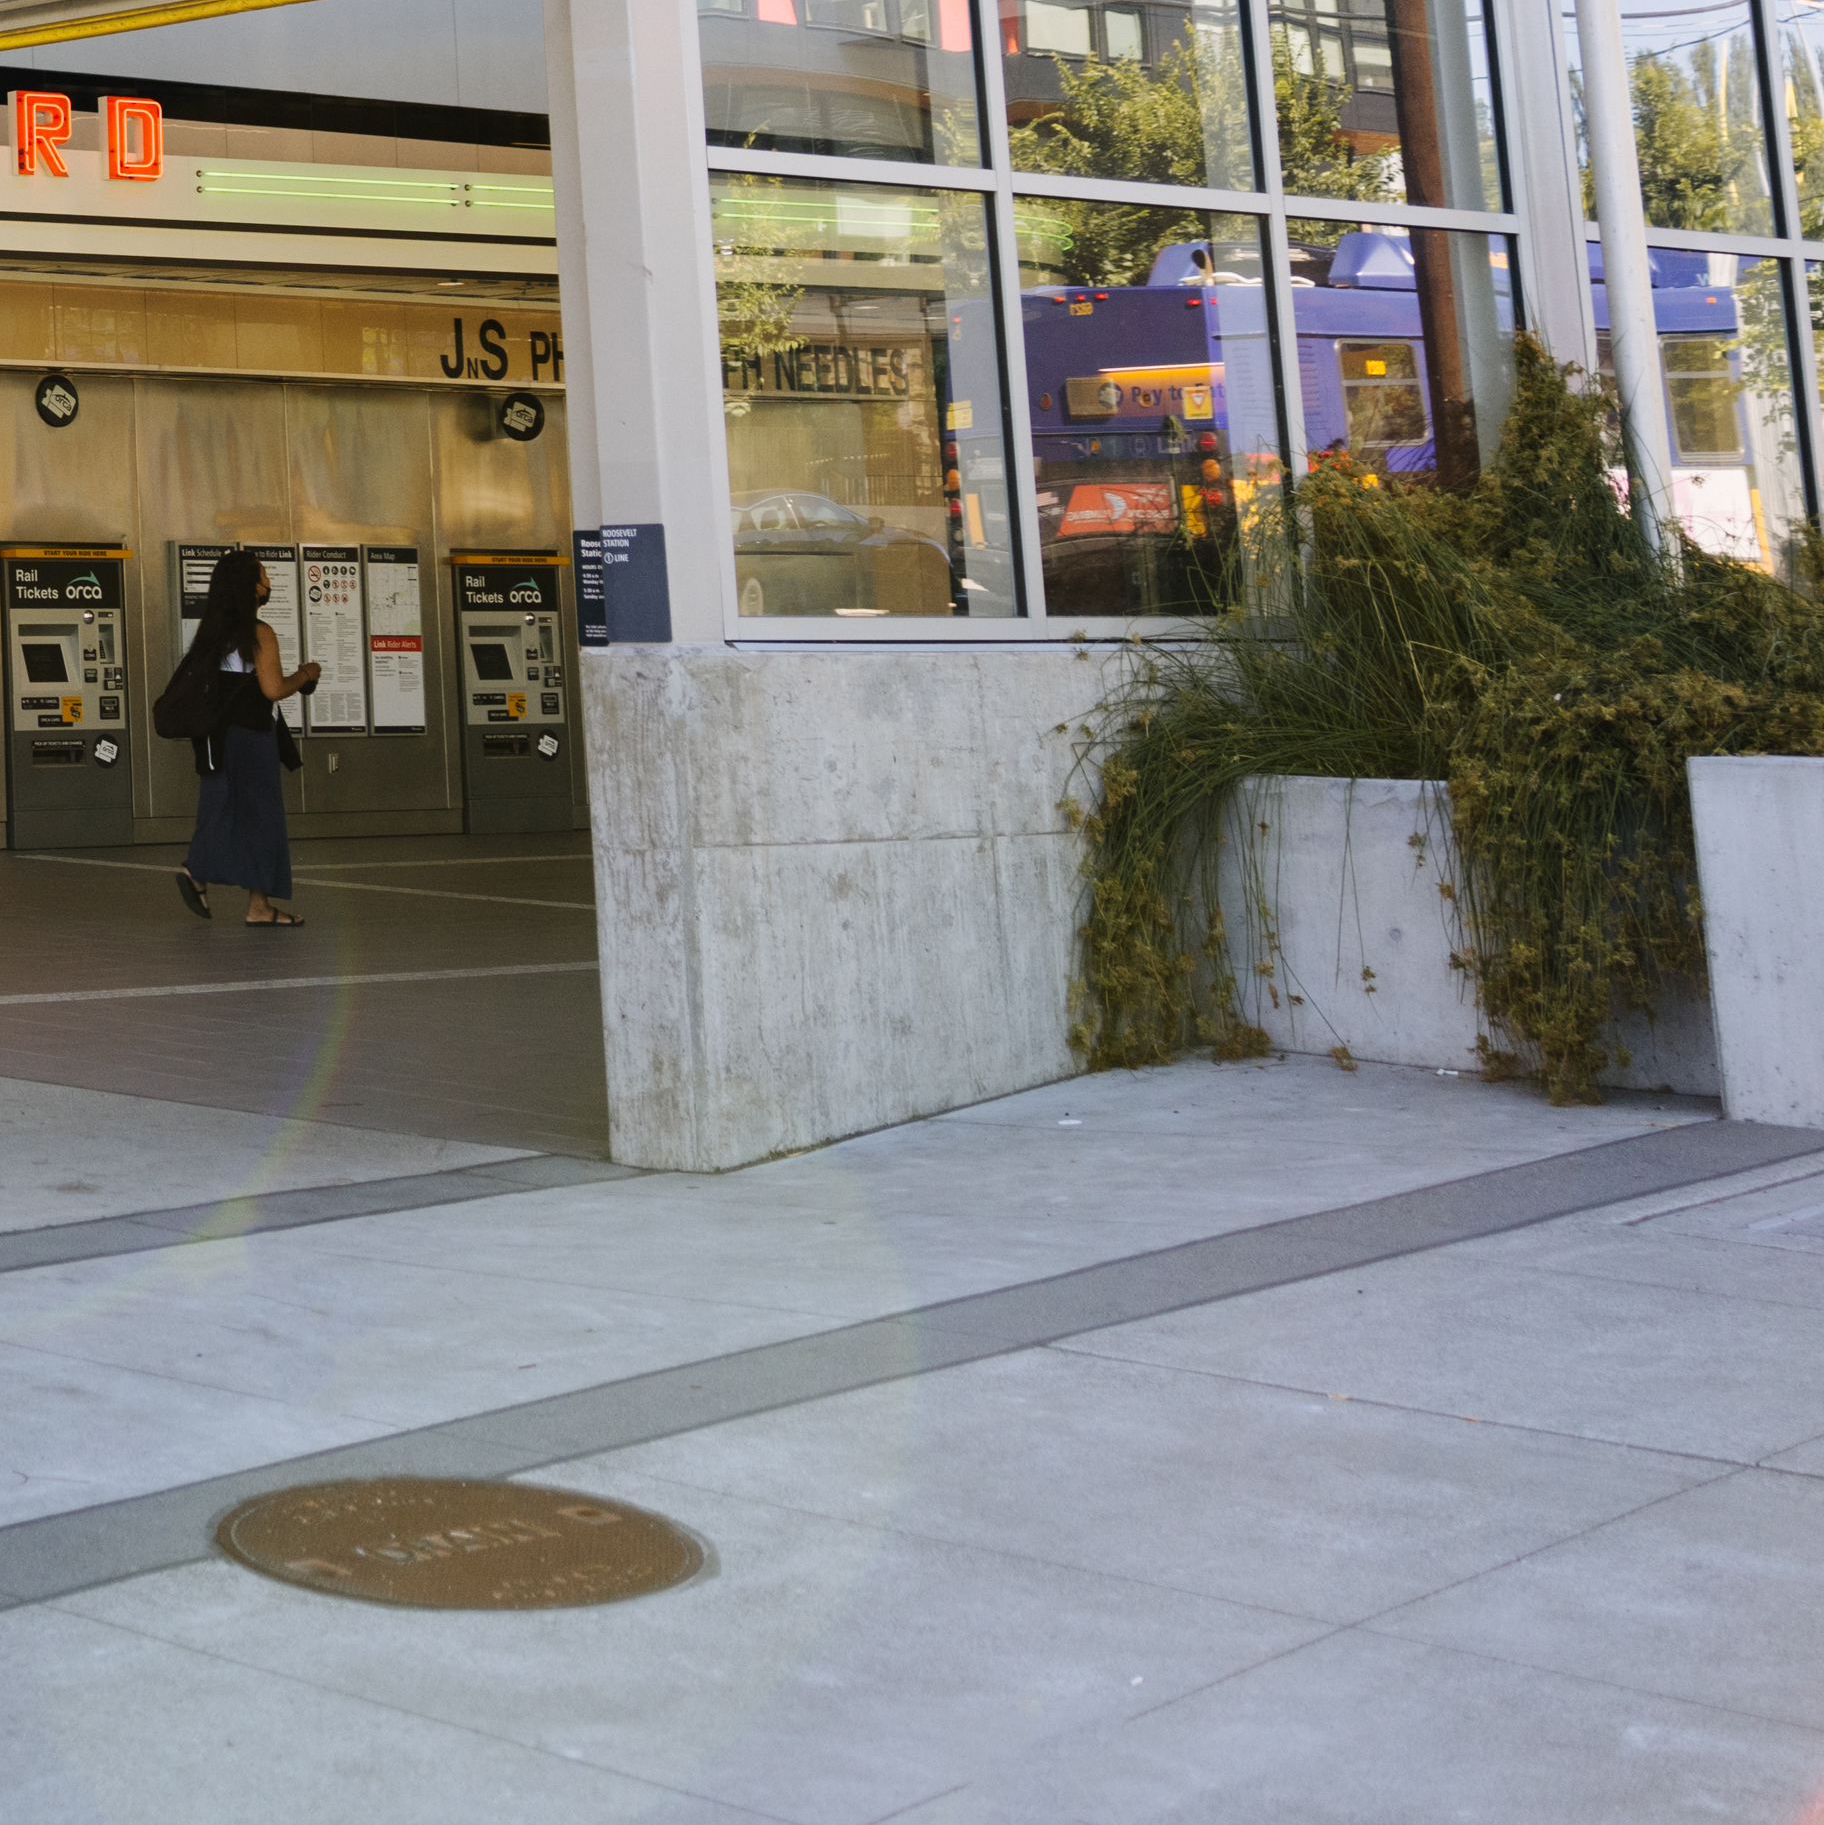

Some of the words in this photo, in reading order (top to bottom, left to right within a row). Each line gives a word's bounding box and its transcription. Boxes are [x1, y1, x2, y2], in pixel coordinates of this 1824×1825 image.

[774, 343, 910, 397] NEEDLES
[54, 395, 73, 413] orca
[515, 410, 534, 424] orca
[602, 529, 638, 537] ROOSEVELT
[603, 539, 630, 547] STATION
[182, 548, 195, 557] Link
[196, 549, 222, 558] Schedule
[266, 550, 278, 558] Ride
[279, 550, 292, 559] Link
[306, 551, 322, 559] Rider
[322, 551, 347, 559] Conduct
[370, 552, 382, 560] Area
[383, 552, 396, 562] Map
[614, 554, 629, 562] LINE
[16, 569, 38, 582] Rail
[465, 576, 485, 587] Rail
[16, 586, 59, 600] Tickets
[66, 585, 102, 600] orca
[466, 591, 504, 603] Tickets
[510, 590, 542, 603] orca
[374, 640, 386, 648] Link
[387, 640, 401, 649] Rider
[401, 640, 417, 649] Alerts
